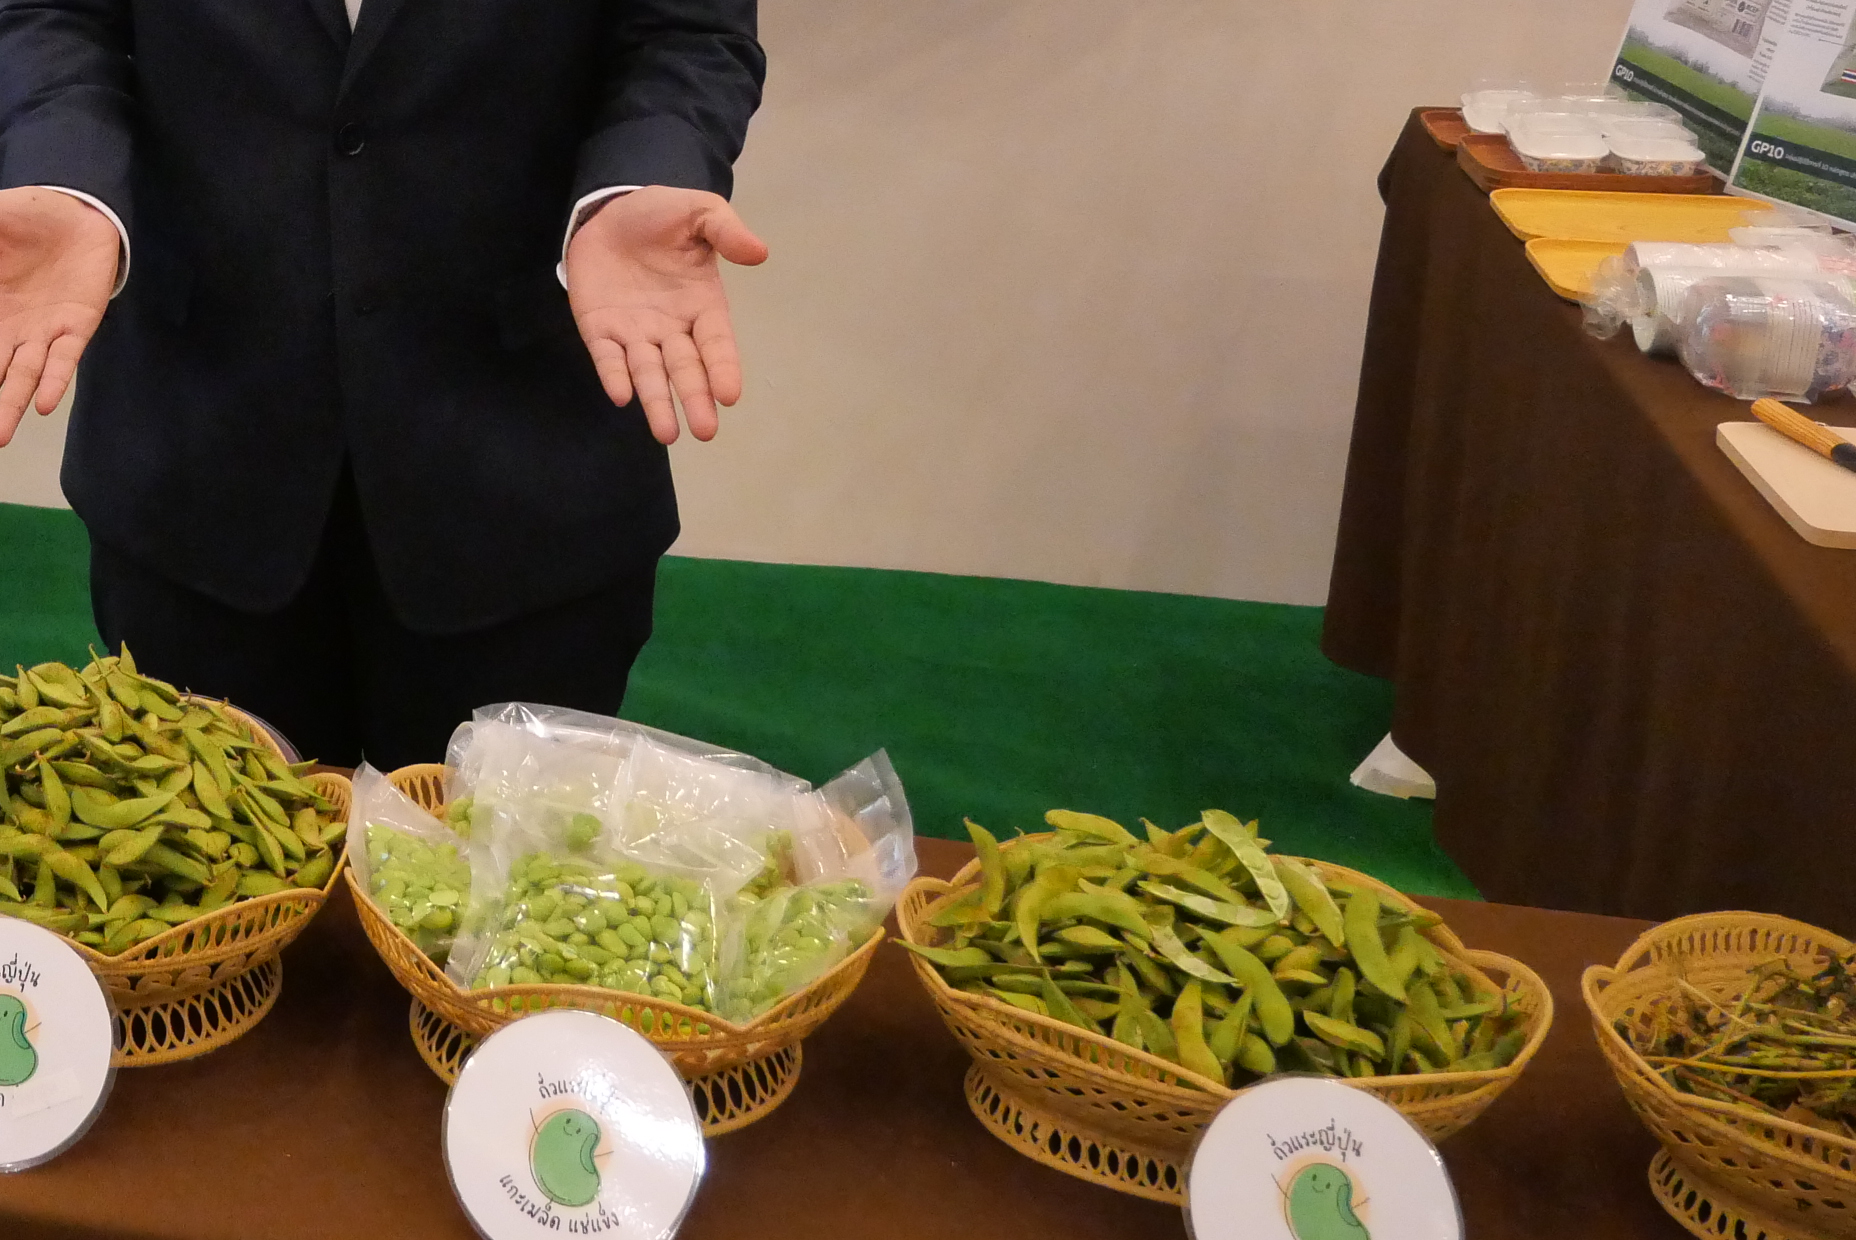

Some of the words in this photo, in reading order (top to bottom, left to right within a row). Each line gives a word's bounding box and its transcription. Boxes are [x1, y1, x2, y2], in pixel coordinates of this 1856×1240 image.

[1615, 64, 1634, 83] GP10
[1750, 140, 1785, 160] GP10
[1266, 1117, 1363, 1163] ถั่วแระญี่ปุ่น
[499, 1174, 561, 1231] แกะเมล็ด
[568, 1201, 620, 1235] แช่แข็ง
